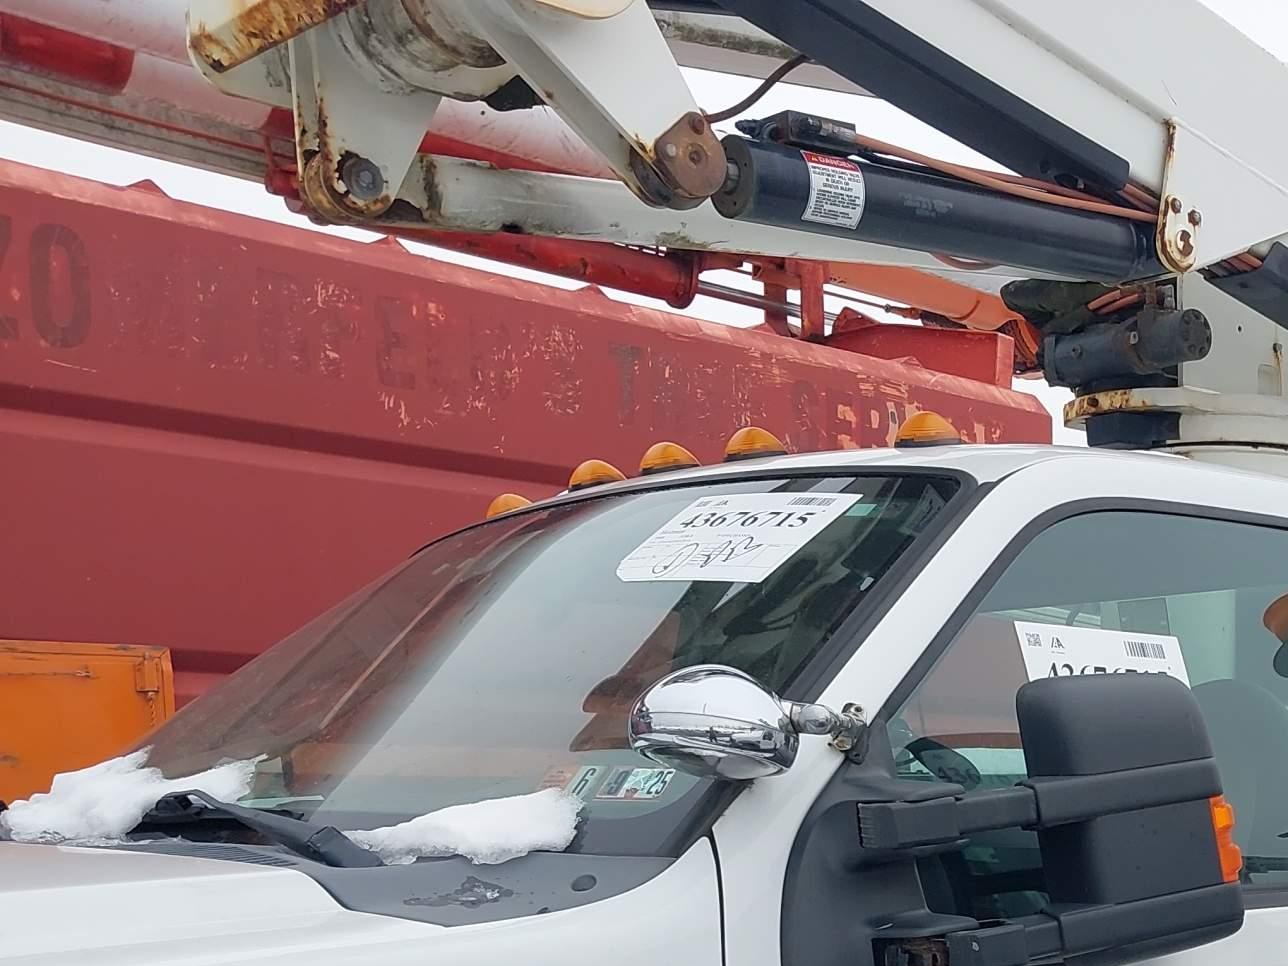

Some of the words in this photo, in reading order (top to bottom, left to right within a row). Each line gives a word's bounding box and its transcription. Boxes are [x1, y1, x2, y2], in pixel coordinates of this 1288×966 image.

[819, 156, 855, 169] DANGER
[680, 512, 817, 528] 43676715
[647, 770, 673, 795] 25
